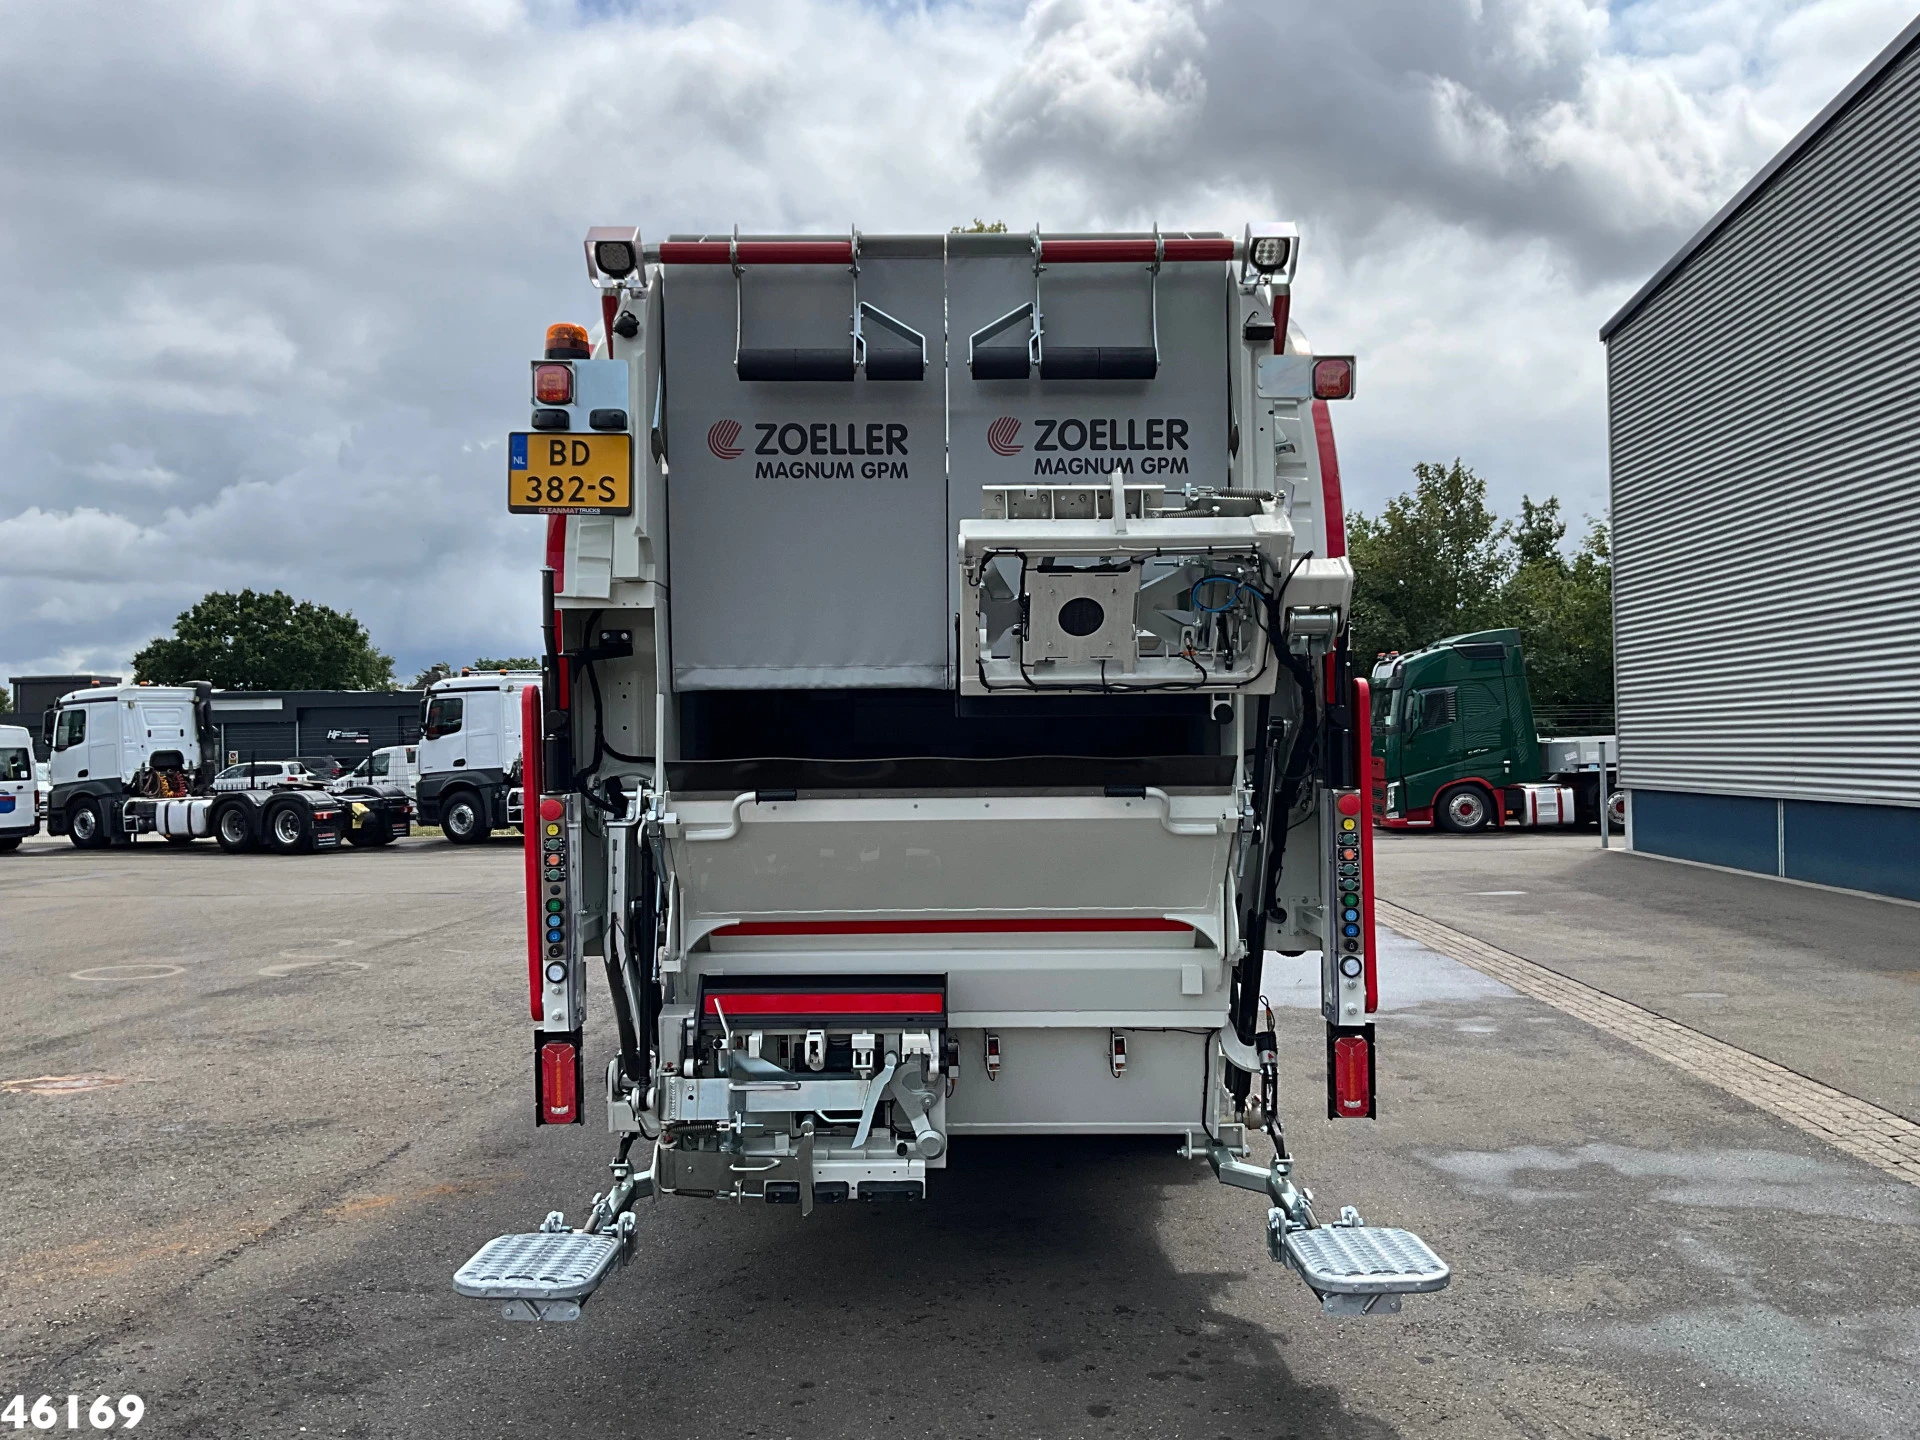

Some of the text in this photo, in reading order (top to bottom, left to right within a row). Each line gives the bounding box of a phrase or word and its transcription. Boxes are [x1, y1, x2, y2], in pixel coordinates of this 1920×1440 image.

[754, 422, 909, 456] ZOELLER
[1034, 418, 1189, 451] ZOELLER
[513, 456, 526, 465] NL
[549, 439, 590, 466] BD
[755, 461, 909, 479] MAGNUM GPM
[1034, 456, 1189, 475] MAGNUM GPM
[525, 475, 616, 503] 382-S
[327, 730, 342, 739] HF
